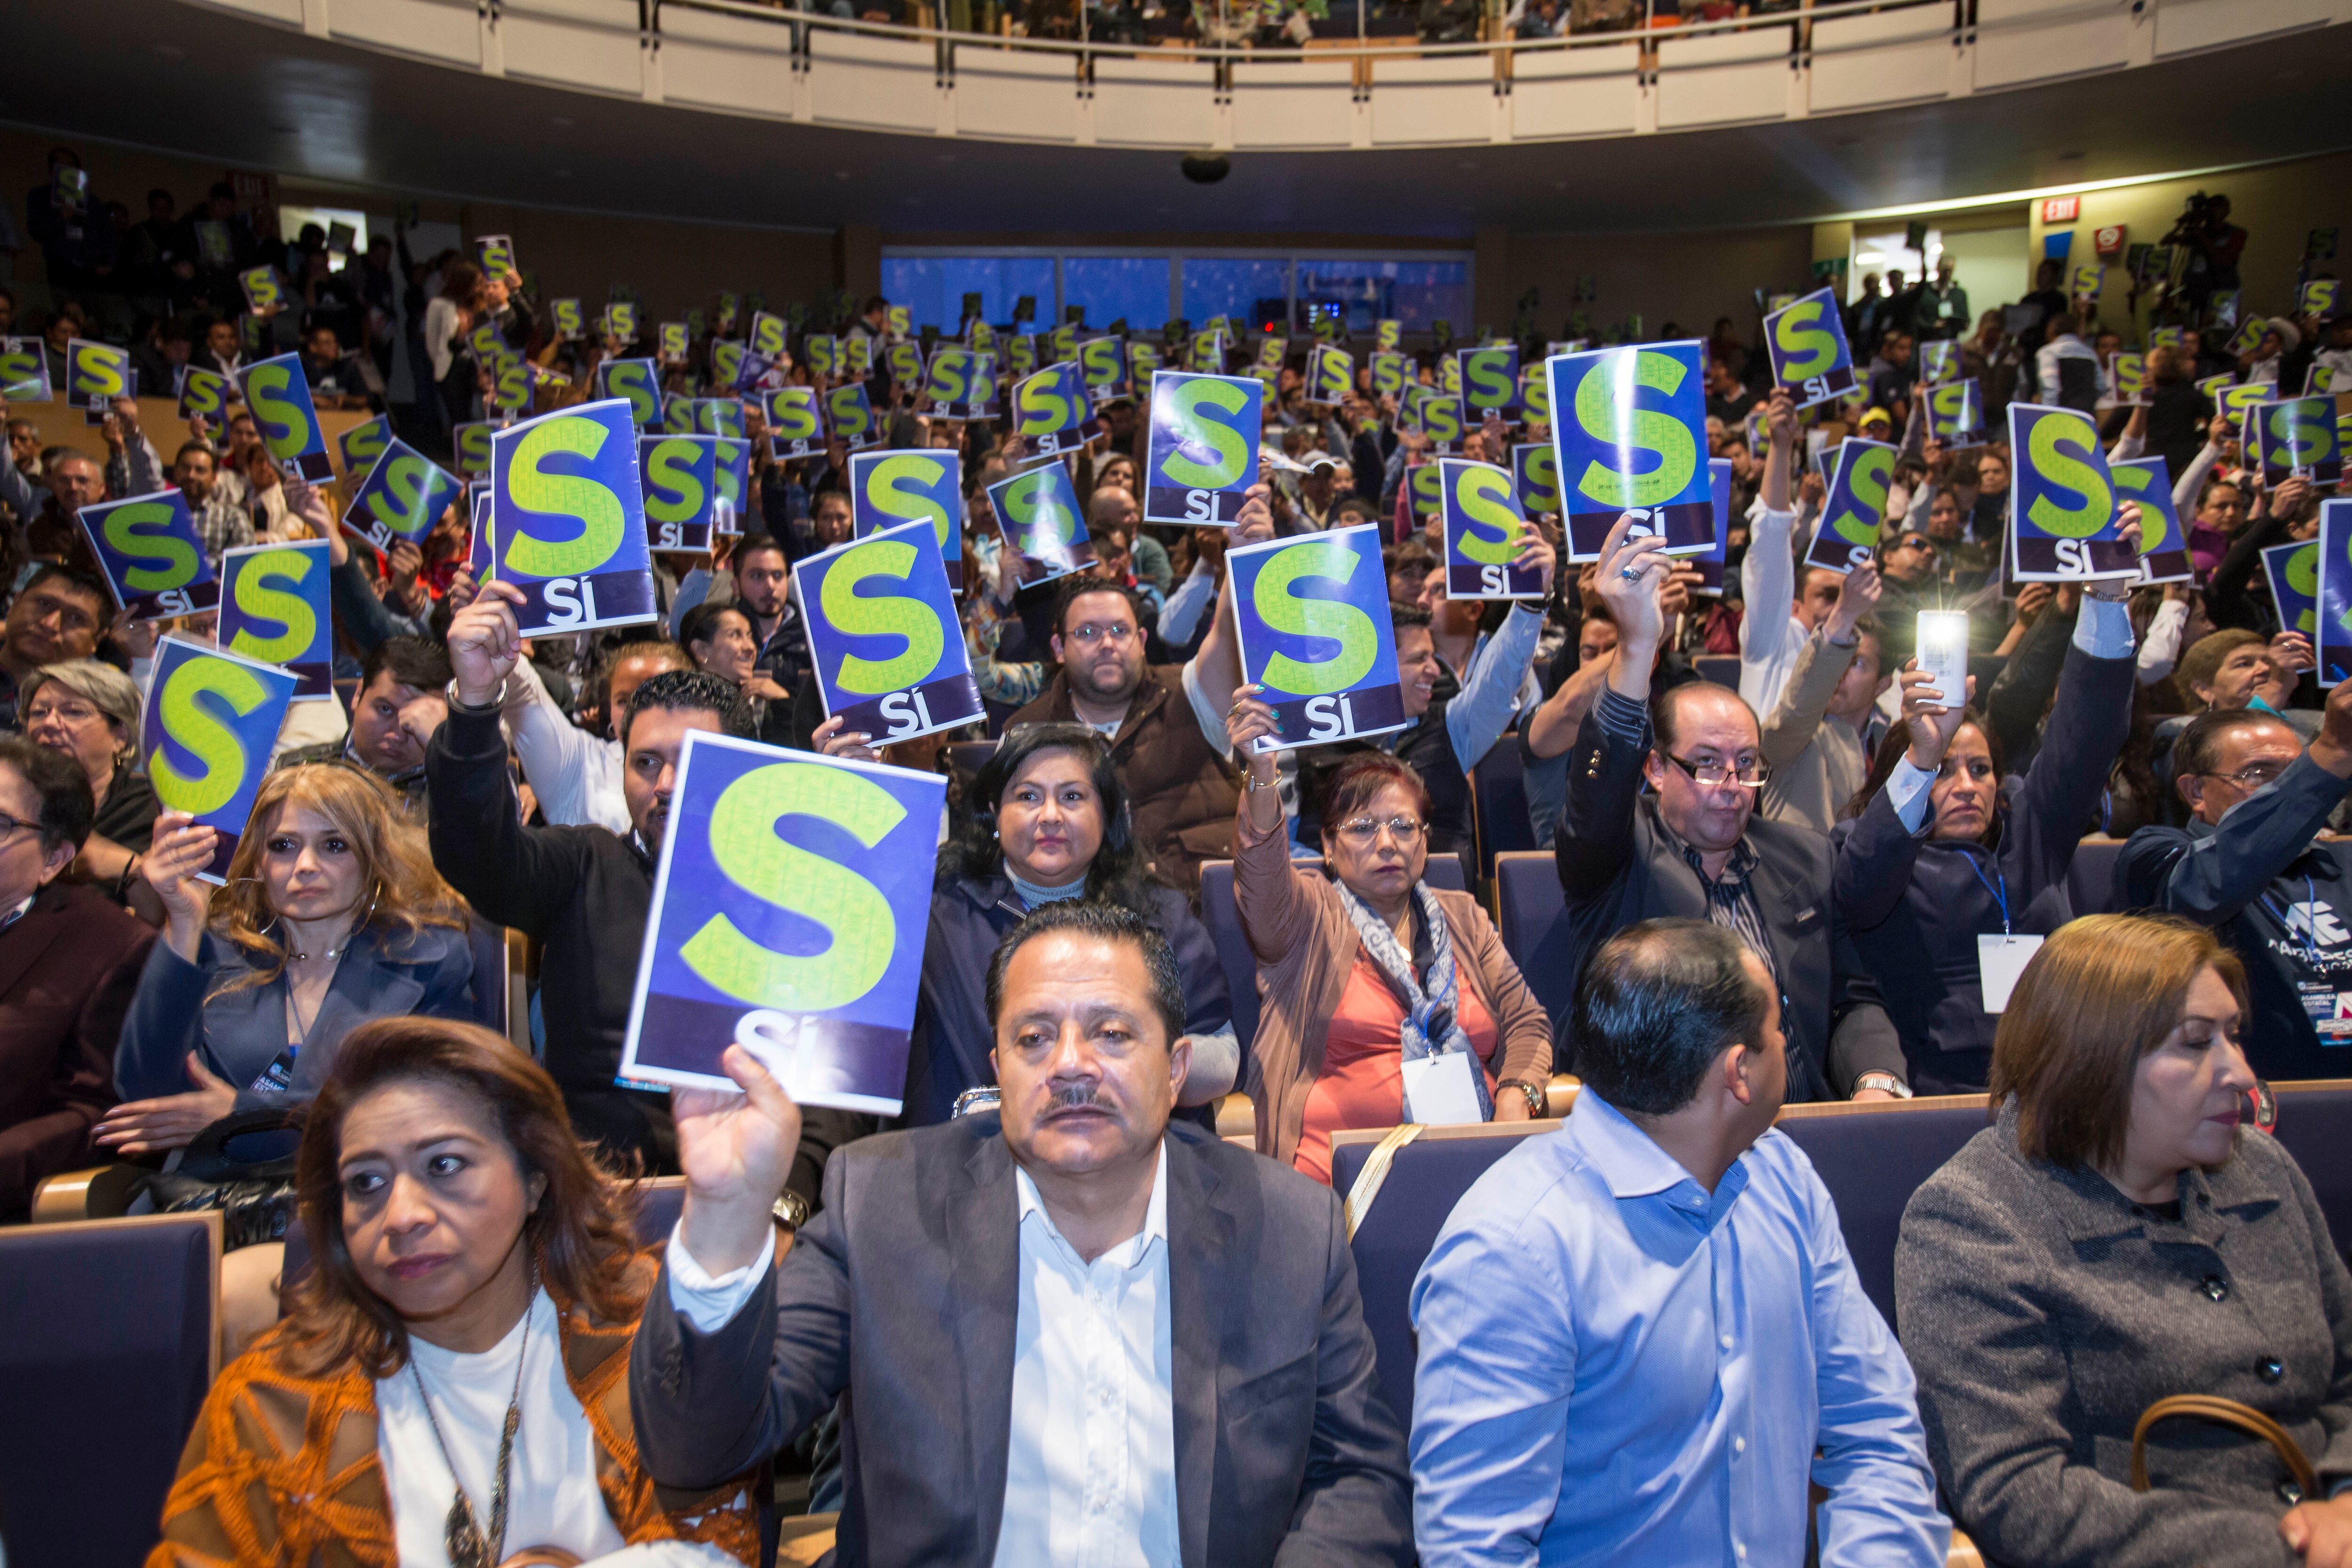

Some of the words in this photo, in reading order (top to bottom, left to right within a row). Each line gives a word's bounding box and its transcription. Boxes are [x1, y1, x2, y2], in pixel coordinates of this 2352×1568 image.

[248, 270, 278, 304] S
[2075, 266, 2100, 292] S
[2305, 282, 2334, 312] S
[557, 300, 580, 330] S
[611, 305, 634, 334] S
[665, 325, 685, 352] S
[756, 317, 784, 353] S
[889, 306, 909, 333] S
[1380, 320, 1398, 346] S
[2237, 319, 2268, 350] S
[715, 344, 742, 384] S
[809, 336, 832, 372] S
[849, 338, 868, 368] S
[893, 345, 920, 381] S
[1010, 336, 1033, 370] S
[1055, 328, 1079, 362] S
[1084, 340, 1120, 385] S
[1263, 338, 1283, 363] S
[1776, 302, 1838, 382] S
[76, 346, 123, 397] S
[185, 372, 223, 413] S
[496, 367, 529, 408] S
[609, 363, 654, 423] S
[928, 353, 967, 402] S
[1320, 350, 1351, 392] S
[1375, 355, 1402, 392] S
[1468, 350, 1513, 408] S
[1804, 374, 1832, 402] Sí
[2117, 355, 2144, 393] S
[248, 365, 309, 460] S
[664, 398, 694, 434] S
[773, 390, 816, 440] S
[831, 388, 869, 436] S
[1020, 371, 1068, 436] S
[1426, 398, 1459, 442] S
[1523, 383, 1551, 424] S
[1933, 384, 1979, 435] S
[461, 424, 492, 471] S
[1160, 379, 1249, 489] S
[1575, 351, 1696, 508] S
[2268, 399, 2333, 467] S
[367, 455, 447, 533] S
[505, 416, 625, 577] S
[645, 439, 705, 523] S
[1413, 465, 1442, 514] S
[1524, 446, 1560, 512] S
[1832, 446, 1897, 547] S
[2027, 413, 2113, 539] S
[866, 454, 950, 549] S
[1005, 472, 1075, 556] S
[1184, 489, 1221, 521] Sí
[1456, 466, 1527, 565] S
[103, 503, 199, 592] S
[367, 520, 394, 552] Sí
[659, 522, 684, 548] Sí
[2054, 538, 2095, 575] Sí
[157, 587, 196, 617] Sí
[544, 575, 597, 626] Sí
[1480, 565, 1511, 596] Sí
[229, 549, 317, 664] S
[820, 540, 945, 694] S
[1253, 542, 1378, 696] S
[880, 685, 933, 737] Sí
[1304, 692, 1356, 740] Sí
[149, 655, 267, 817] S
[679, 761, 908, 1012] S
[734, 1008, 822, 1093] Sí
